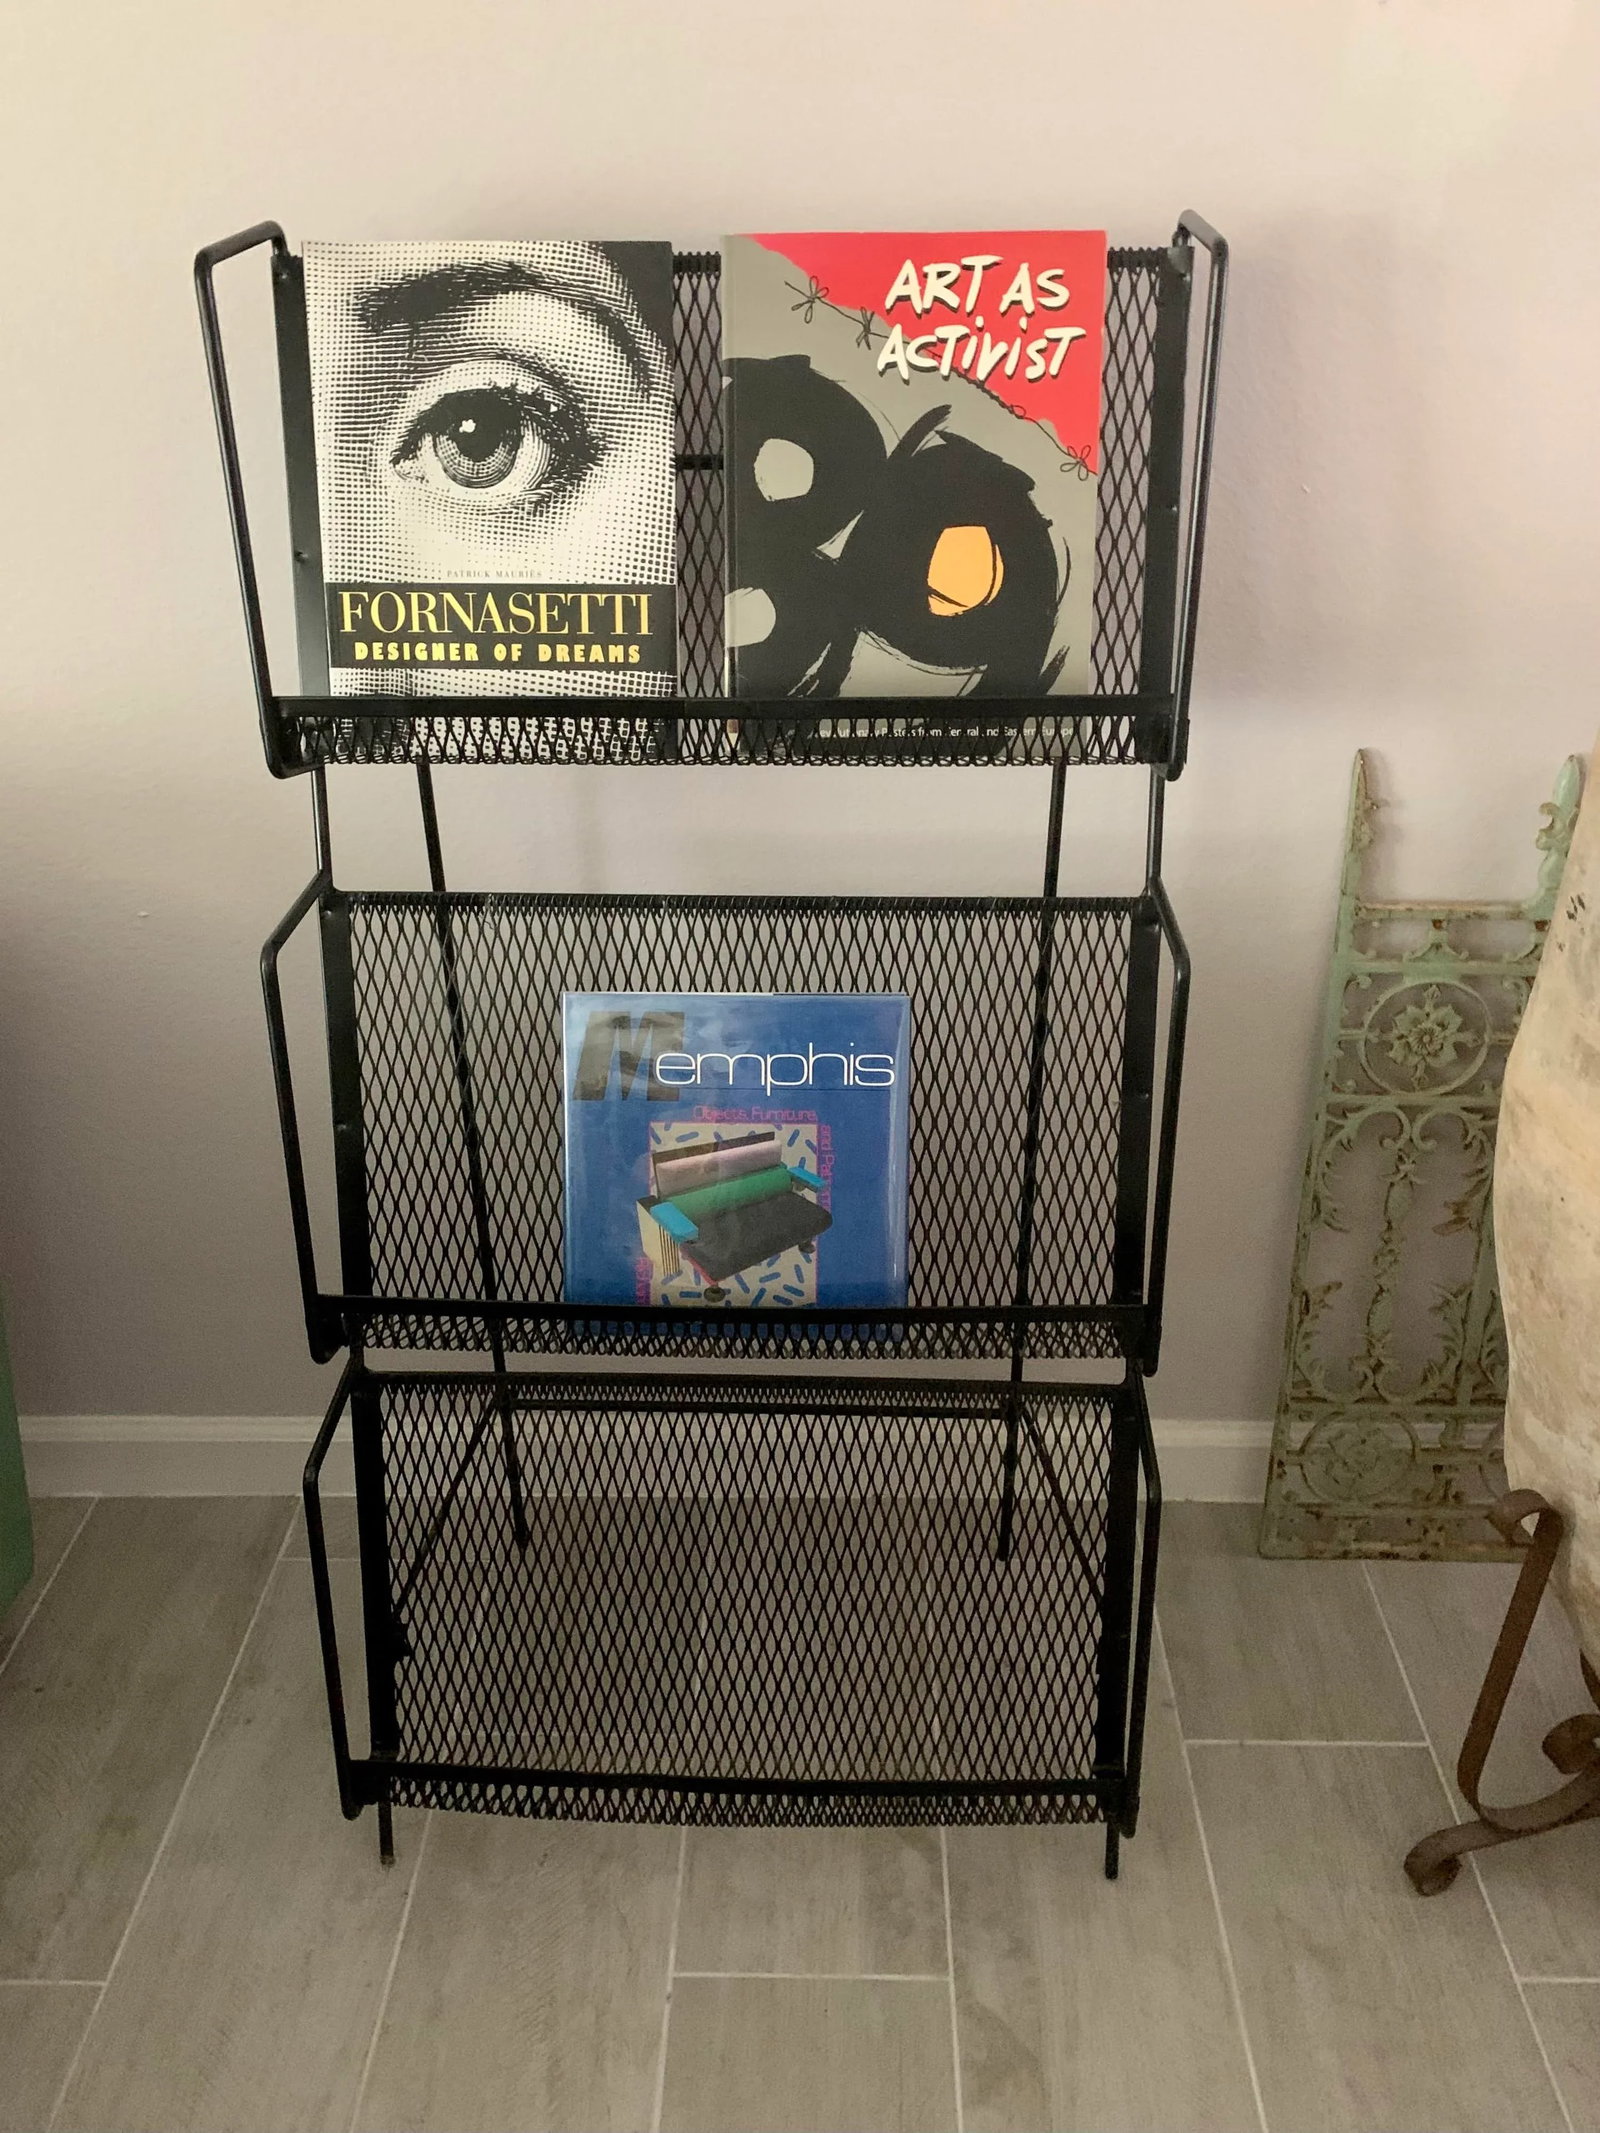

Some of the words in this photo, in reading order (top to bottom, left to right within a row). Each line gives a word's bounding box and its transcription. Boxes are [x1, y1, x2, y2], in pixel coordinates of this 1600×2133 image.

[885, 254, 1003, 316] ART
[999, 262, 1070, 315] AS
[447, 570, 490, 578] PATRICK
[338, 591, 654, 636] FORNASETTI
[355, 641, 479, 662] DESIGNER
[494, 643, 523, 662] OF
[538, 643, 642, 664] DREAMS
